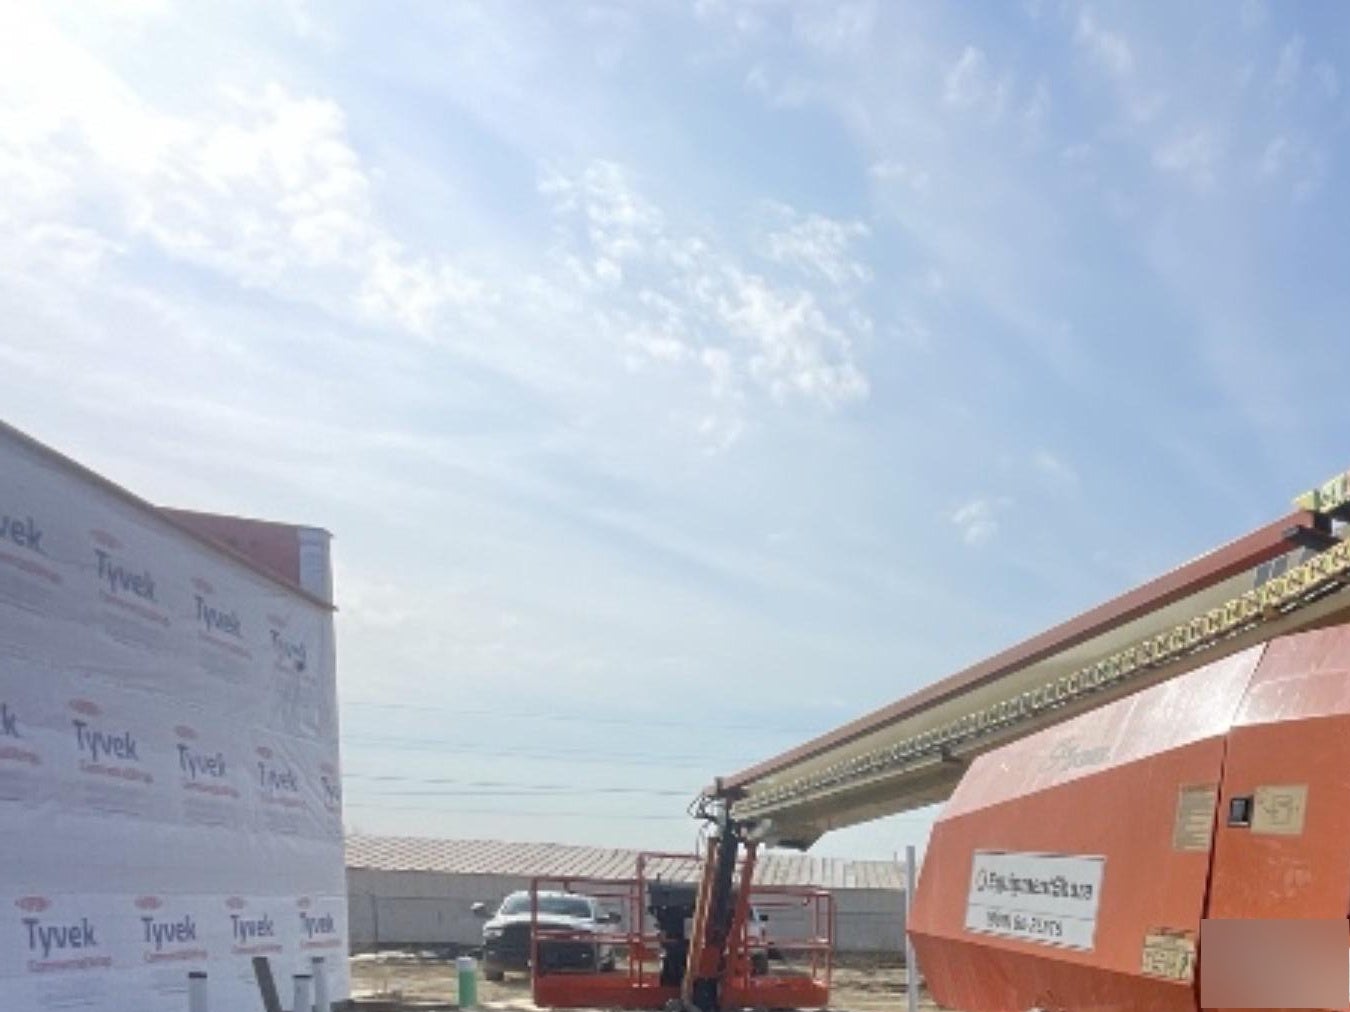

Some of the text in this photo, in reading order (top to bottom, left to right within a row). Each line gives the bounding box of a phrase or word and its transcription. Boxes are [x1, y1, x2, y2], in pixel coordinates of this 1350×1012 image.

[93, 548, 158, 603] Tyvek
[194, 595, 244, 639] Tyvek
[72, 718, 140, 763] Tyvek
[176, 743, 228, 780] Tyvek
[21, 916, 98, 957] Tyvek
[140, 914, 197, 951] Tyvek
[230, 913, 275, 940] Tyvek
[300, 912, 335, 938] Tyvek
